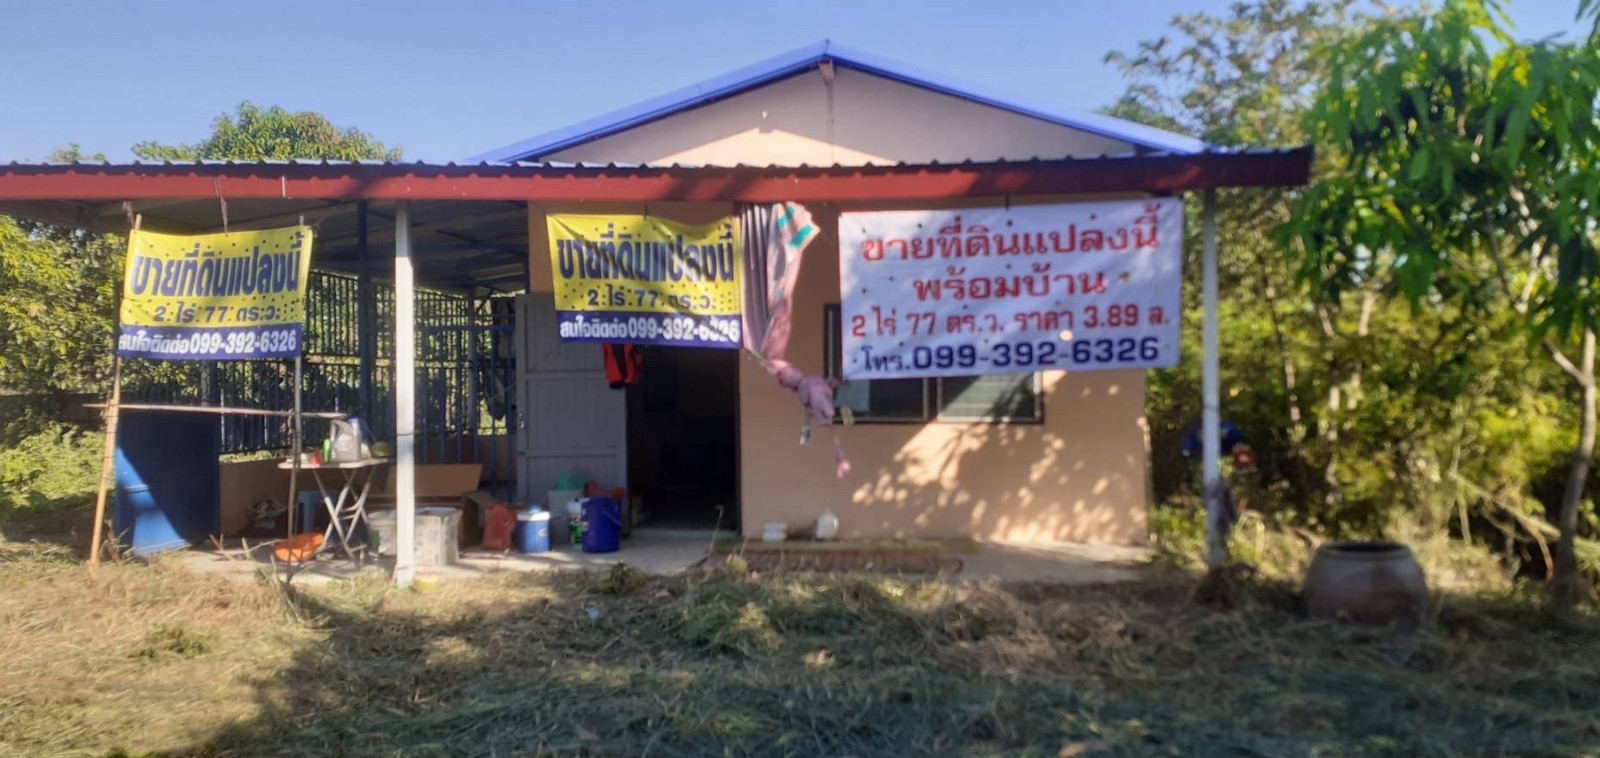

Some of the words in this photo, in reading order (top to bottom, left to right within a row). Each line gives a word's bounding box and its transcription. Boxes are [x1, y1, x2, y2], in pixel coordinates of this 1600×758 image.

[860, 203, 1161, 262] ขายที่ดินแปลงนี้
[131, 231, 305, 297] ขายที่ดินแปลงนี้
[587, 289, 600, 306] 2
[604, 283, 626, 307] ไร่
[635, 289, 659, 307] 77
[913, 263, 1107, 302] พร้อมบ้าน
[153, 305, 167, 322] 2
[176, 301, 195, 323] ไร่
[204, 306, 229, 323] 77
[852, 314, 867, 338] 2
[871, 306, 897, 338] ไร่
[906, 313, 937, 336] 77
[1015, 310, 1074, 333] ราคา
[1083, 304, 1139, 329] 3.89
